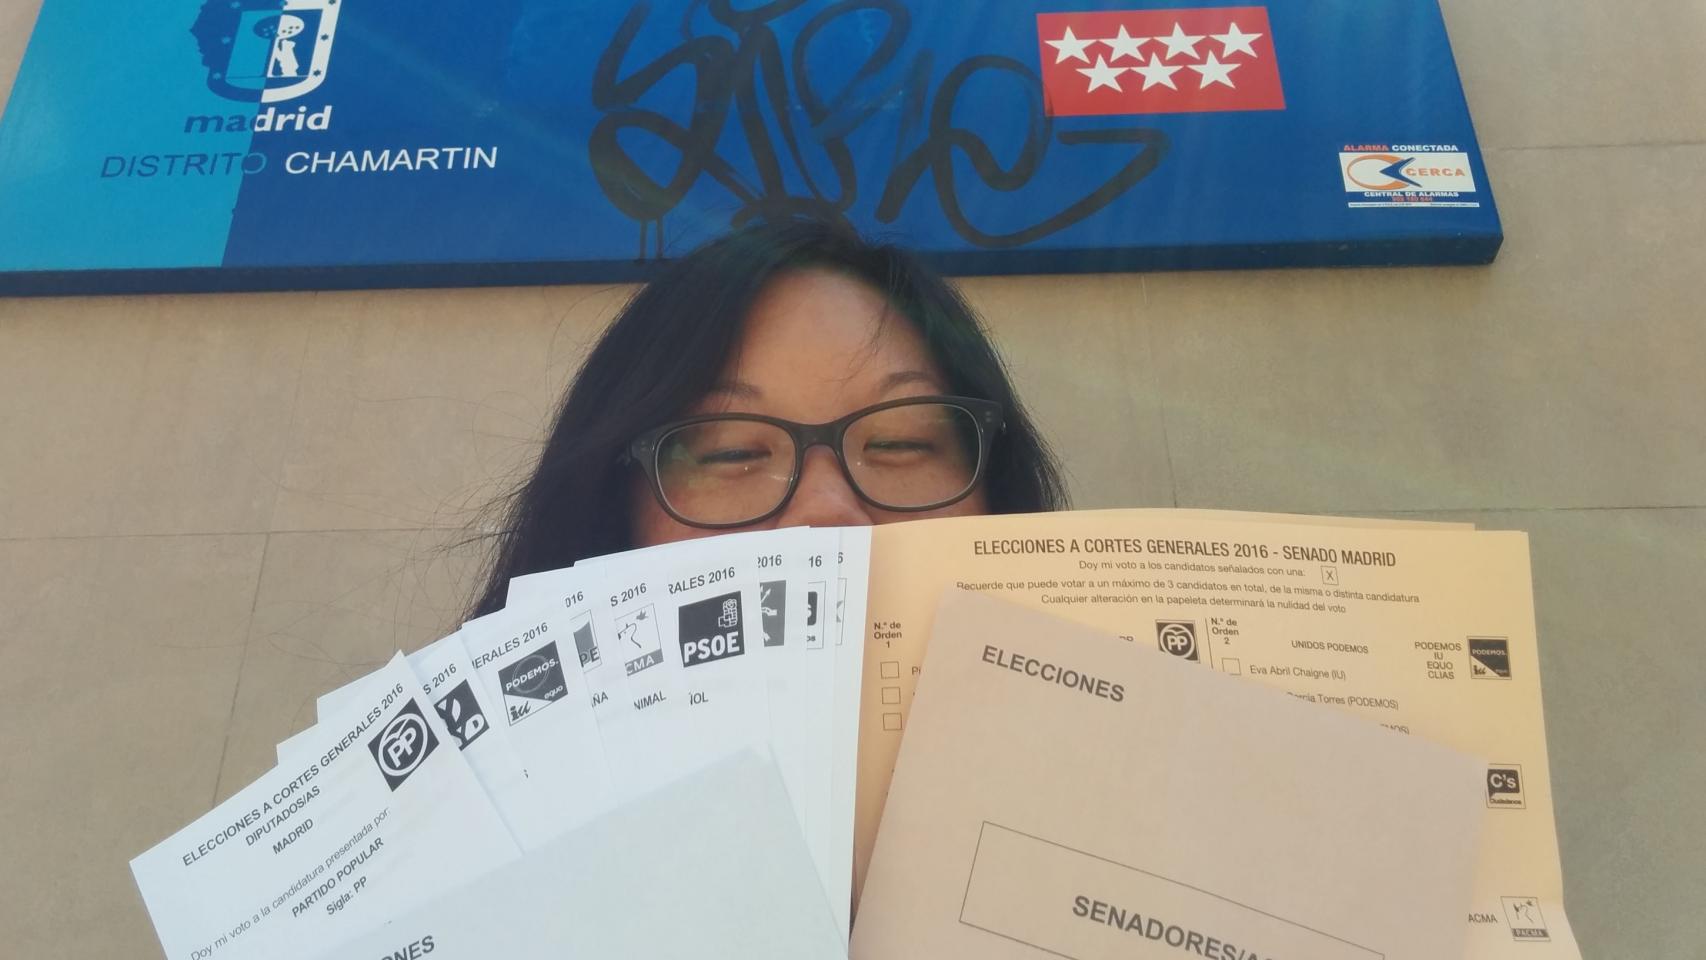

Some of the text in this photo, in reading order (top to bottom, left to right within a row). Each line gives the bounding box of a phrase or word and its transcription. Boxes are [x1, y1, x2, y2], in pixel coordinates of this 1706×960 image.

[184, 106, 332, 133] madrid
[1343, 144, 1389, 152] ALARMA
[101, 147, 497, 178] DISTRITO CHAMARTIN
[1405, 168, 1465, 177] CERCA
[974, 539, 1065, 555] ELECCIONES
[1070, 539, 1080, 553] A
[1084, 539, 1143, 553] CORTES
[1146, 539, 1230, 557] GENERALES
[1233, 543, 1269, 559] 2016
[1283, 545, 1337, 563] SENADO
[1341, 550, 1396, 567] MADRID
[708, 566, 735, 584] 2016
[1079, 560, 1098, 571] Doy
[1101, 561, 1113, 569] mi
[1115, 561, 1137, 570] voto
[1148, 560, 1162, 570] los
[1164, 562, 1216, 572] candidatos
[1218, 564, 1265, 574] señalados
[1267, 567, 1284, 575] con
[1326, 570, 1334, 581] X
[610, 583, 647, 607] S 2016
[956, 580, 1004, 591] Recuerde
[1006, 581, 1025, 591] que
[1028, 580, 1058, 590] puede
[1061, 579, 1086, 588] votar
[1112, 579, 1151, 588] máximo
[1153, 580, 1165, 588] de
[1167, 580, 1174, 589] 3
[1177, 581, 1228, 591] candidatos
[1270, 585, 1281, 593] de
[1283, 585, 1292, 594] la
[1294, 586, 1323, 597] misma
[1333, 590, 1364, 600] distinta
[1366, 592, 1420, 603] candidatura
[1041, 594, 1088, 605] Cualquier
[1091, 594, 1138, 603] alteración
[1155, 595, 1164, 603] la
[1167, 596, 1207, 605] papeleta
[1209, 597, 1265, 608] determinará
[1267, 600, 1275, 608] la
[1277, 600, 1310, 610] nulidad
[1312, 602, 1325, 611] del
[1328, 604, 1346, 613] voto
[1211, 627, 1239, 636] Orden
[1226, 618, 1238, 626] de
[522, 622, 549, 644] 2016
[874, 631, 902, 639] Orden
[1224, 637, 1231, 645] 2
[683, 631, 740, 664] PSOE
[1166, 635, 1188, 651] PP
[1291, 640, 1369, 654] UNIDOS PODEMOS
[1414, 641, 1462, 651] PODEMOS
[1426, 661, 1453, 670] EQUO
[1434, 652, 1443, 660] IU
[423, 663, 457, 695] S 2016
[981, 644, 1126, 703] ELECCIONES
[1250, 664, 1346, 681] Eva Abril Chaigne (IU)
[1428, 671, 1455, 680] CLIAS
[544, 685, 564, 700] equo
[1317, 693, 1345, 705] Torres
[1347, 695, 1399, 711] (PODEMOS)
[387, 727, 418, 768] PP
[182, 683, 404, 866] ELECCIONES A CORTES GENERALES 2016
[1489, 773, 1517, 789] C's
[245, 785, 321, 847] DIPUTADOS/AS
[272, 818, 314, 855] MADRID
[291, 837, 384, 918] PARTIDO POPULAR
[191, 945, 212, 960] Doy
[215, 935, 228, 949] mi
[230, 921, 251, 939] voto
[253, 914, 260, 923] a
[260, 906, 271, 918] la
[272, 864, 325, 909] candidatura
[324, 823, 374, 869] presentada
[326, 876, 368, 916] Sigla: PP
